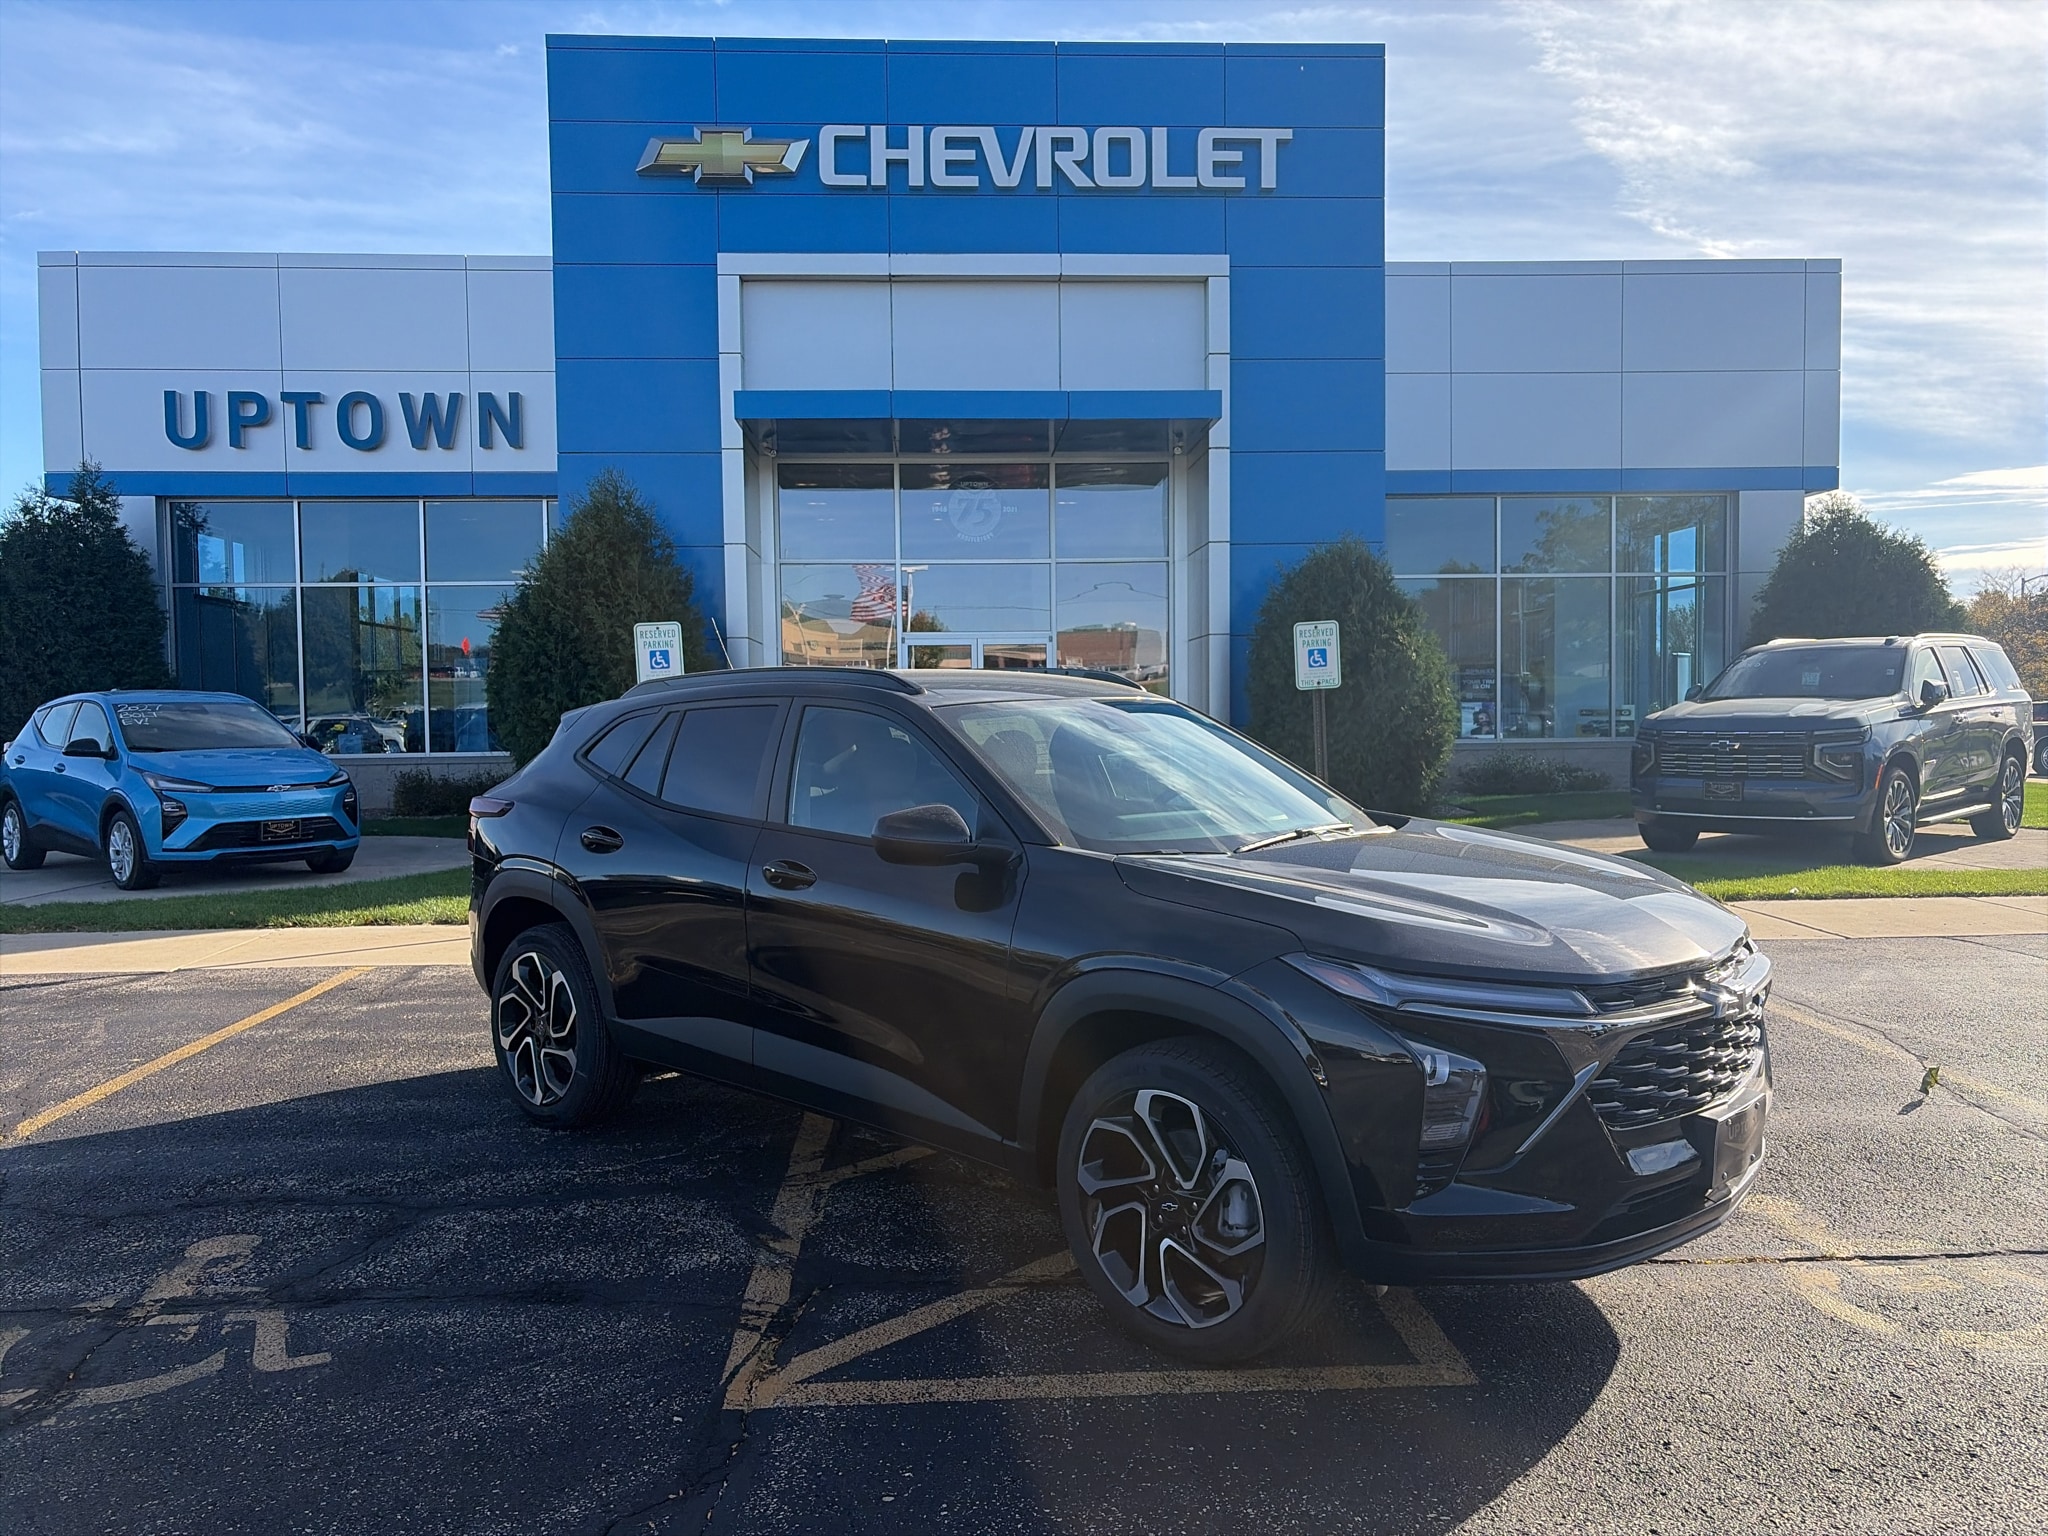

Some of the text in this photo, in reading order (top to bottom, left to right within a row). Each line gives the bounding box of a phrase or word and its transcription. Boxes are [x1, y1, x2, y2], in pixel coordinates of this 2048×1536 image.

[818, 125, 1294, 188] CHEVROLET
[163, 390, 524, 452] UPTOWN
[956, 498, 993, 525] 75
[639, 629, 676, 639] RESERVED
[1298, 628, 1334, 638] RESERVED
[643, 640, 674, 649] PARKING
[1302, 638, 1332, 648] PARKING
[117, 703, 162, 713] 2027
